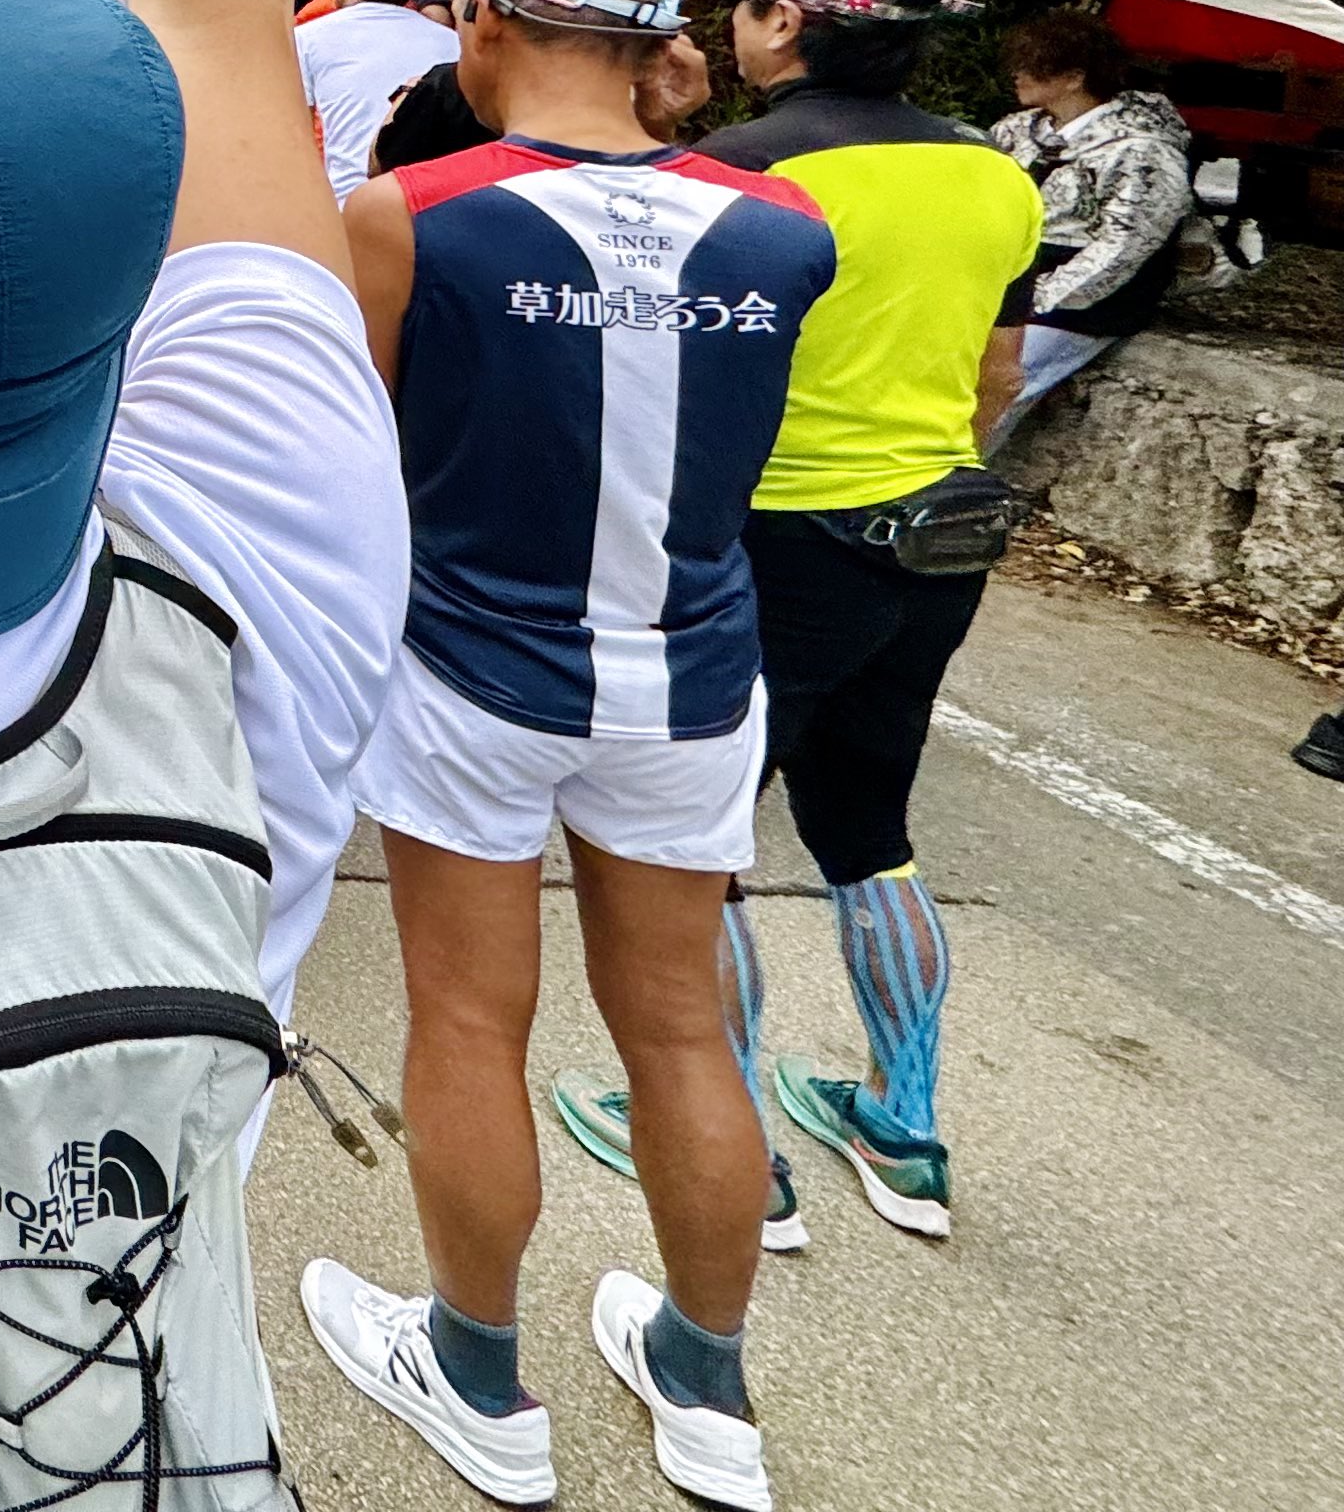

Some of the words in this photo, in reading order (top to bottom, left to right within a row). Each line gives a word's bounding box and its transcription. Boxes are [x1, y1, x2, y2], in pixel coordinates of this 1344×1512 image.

[597, 233, 673, 251] SINCE
[615, 253, 661, 270] 1976
[505, 281, 778, 334] 草加走ろう会
